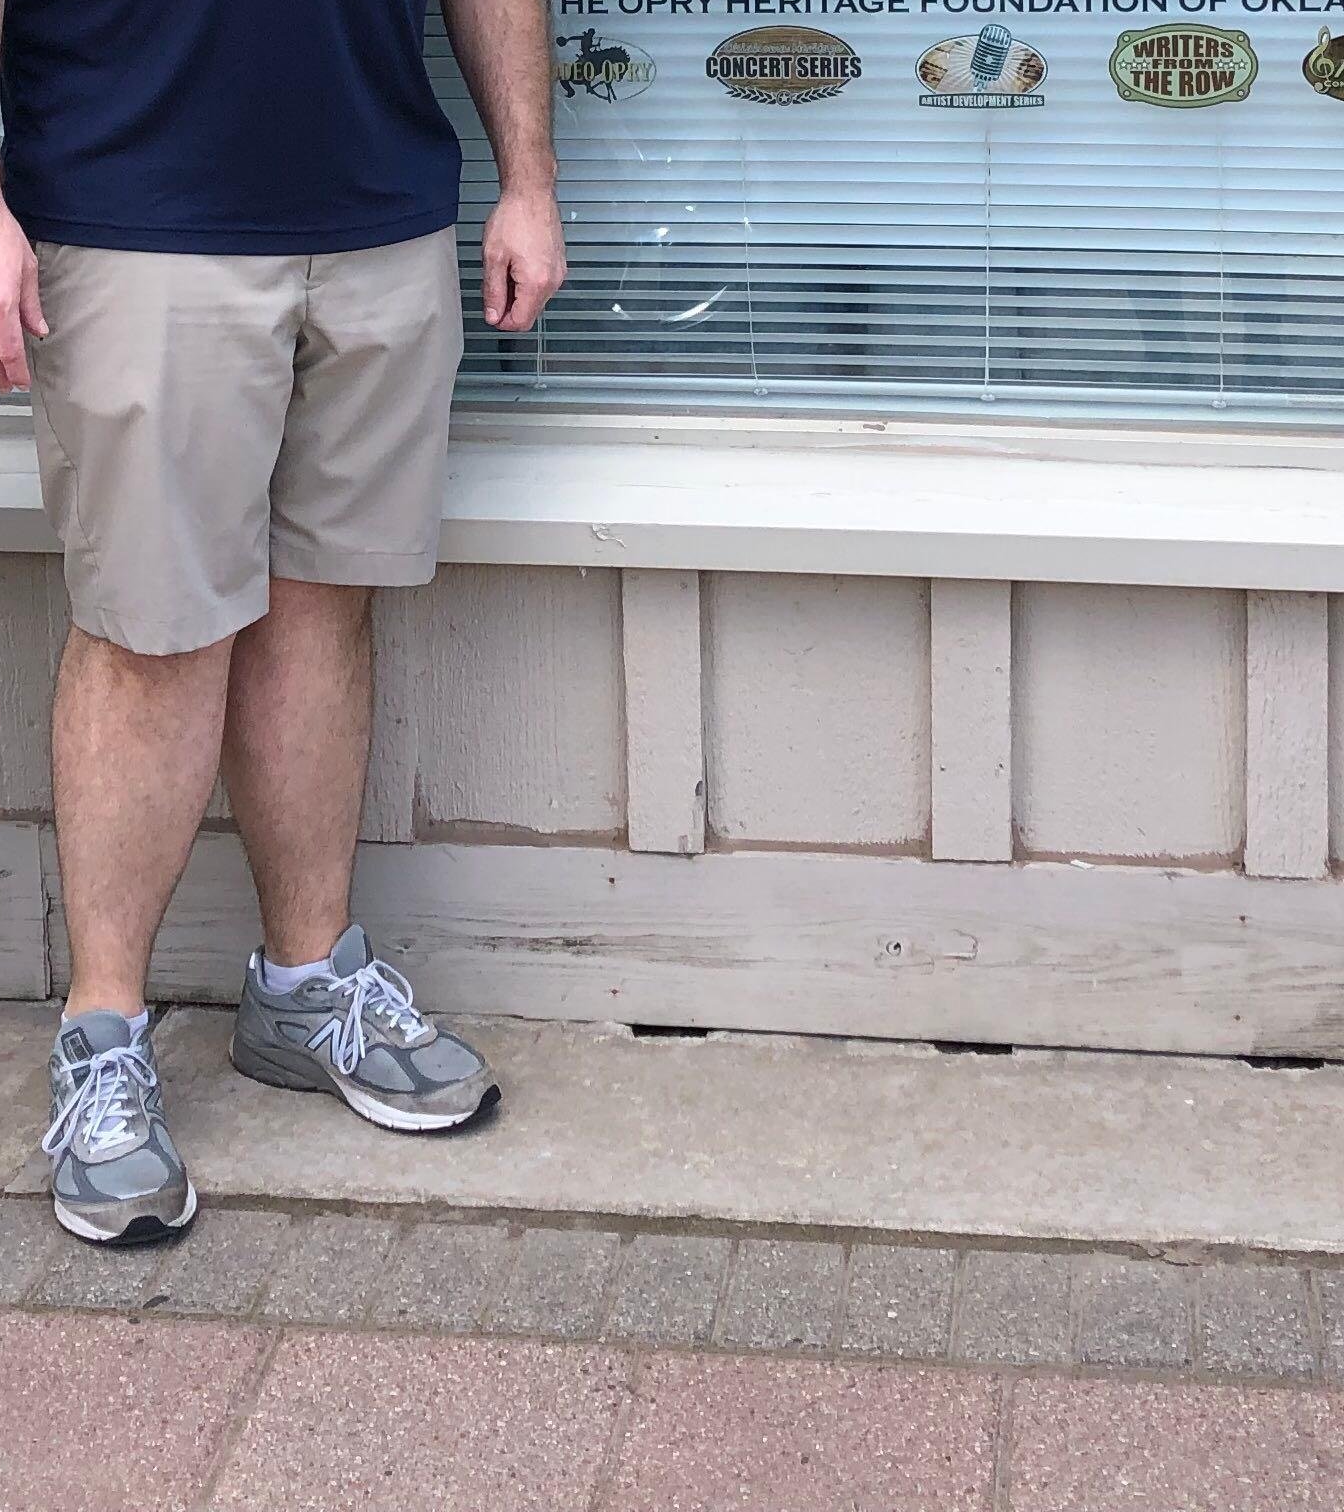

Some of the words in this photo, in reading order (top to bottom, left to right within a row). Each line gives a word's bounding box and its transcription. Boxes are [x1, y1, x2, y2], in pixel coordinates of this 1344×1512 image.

[1133, 34, 1234, 59] WRITERS
[601, 59, 654, 83] OPRY
[706, 56, 793, 79] CONCERT
[796, 56, 862, 79] SERIES
[1151, 59, 1214, 70] FROM
[1130, 70, 1173, 96] THE
[1179, 70, 1236, 97] ROW
[921, 95, 951, 106] ARTIST
[952, 94, 1012, 107] DEVELOPMENT
[1013, 95, 1043, 106] SERIES
